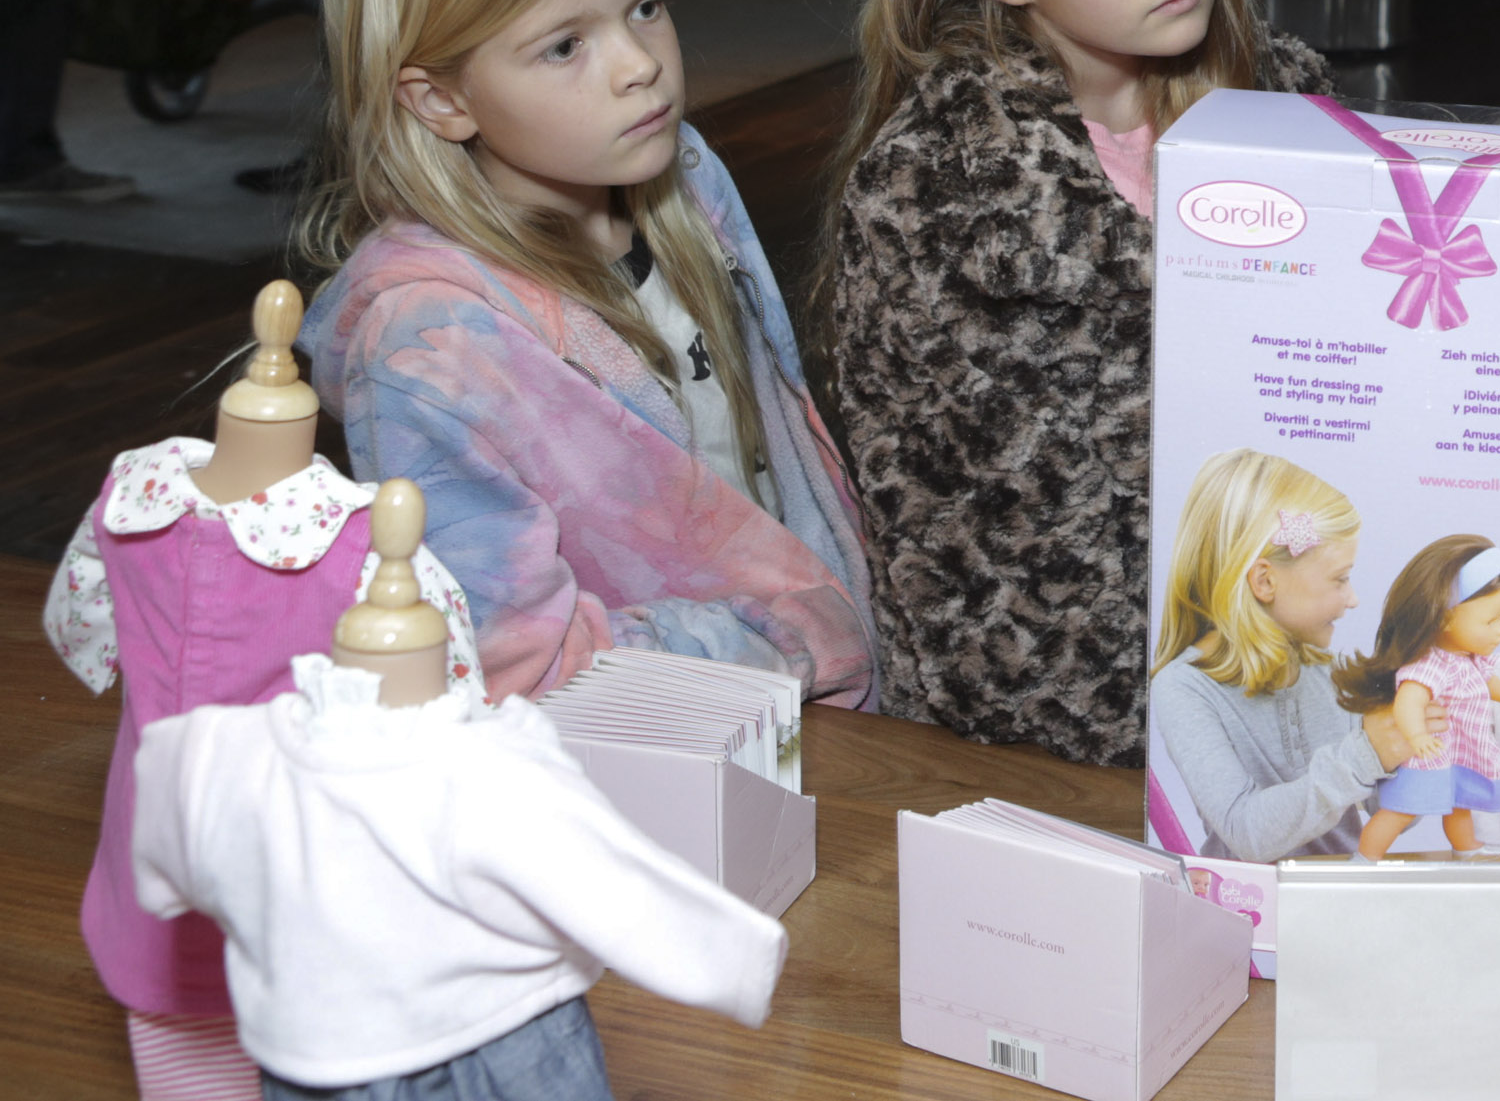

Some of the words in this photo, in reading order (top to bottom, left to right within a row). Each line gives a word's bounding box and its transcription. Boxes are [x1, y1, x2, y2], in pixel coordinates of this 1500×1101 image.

[1190, 197, 1295, 230] Corolle
[1165, 254, 1239, 270] parfums
[1242, 258, 1318, 276] D'ENFANCE
[1251, 334, 1312, 349] Amuse-toi
[1327, 341, 1388, 355] m'habiller
[1277, 350, 1289, 360] et
[1293, 351, 1312, 362] me
[1315, 353, 1357, 366] coiffer!
[1441, 349, 1467, 362] Zieh
[1471, 351, 1500, 364] mich
[1254, 372, 1285, 386] Have
[1288, 375, 1307, 387] fun
[1311, 377, 1361, 394] dressing
[1365, 383, 1384, 394] me
[1259, 387, 1282, 398] and
[1286, 389, 1324, 404] styling
[1328, 394, 1346, 406] my
[1349, 393, 1377, 407] hair!
[1452, 404, 1460, 415] y
[1264, 411, 1310, 426] Divertiti
[1313, 418, 1321, 427] a
[1325, 418, 1371, 432] vestirmi
[1278, 427, 1287, 437] e
[1289, 428, 1356, 443] pettinarmi!
[1435, 440, 1459, 451] aan
[1462, 441, 1475, 452] te
[966, 918, 1065, 956] www.corolle.com
